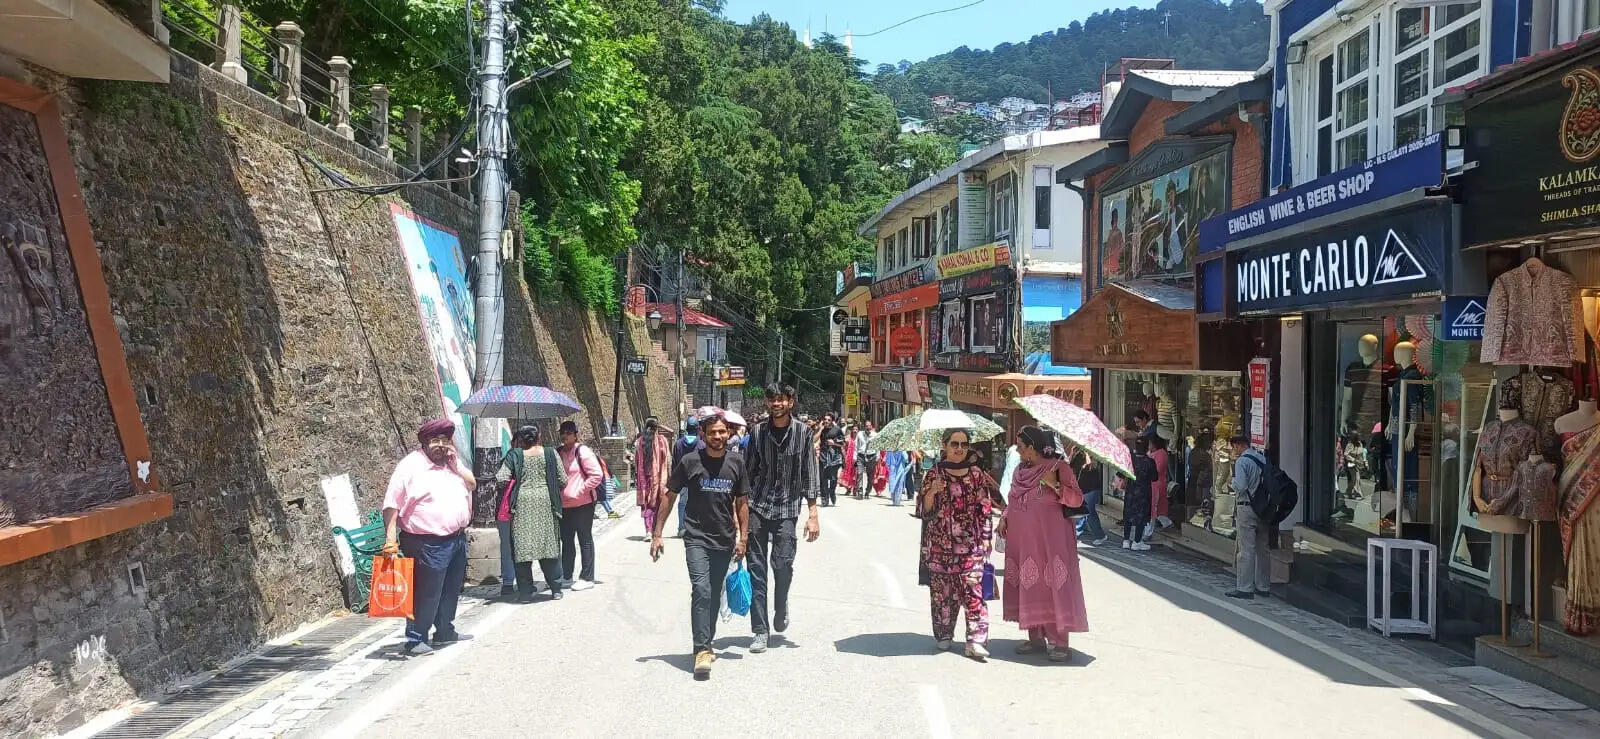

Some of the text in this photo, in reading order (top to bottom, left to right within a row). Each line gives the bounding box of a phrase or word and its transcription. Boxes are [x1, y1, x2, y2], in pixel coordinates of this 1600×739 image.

[1538, 165, 1600, 191] KALAMK
[1228, 171, 1375, 235] ENGLISH WINE & BEER SHOP
[1543, 190, 1572, 201] THREADS
[1573, 188, 1582, 196] OF
[1540, 207, 1579, 223] SHIMLA
[1236, 234, 1370, 303] MONTE CARLO
[1451, 328, 1478, 337] MONTE
